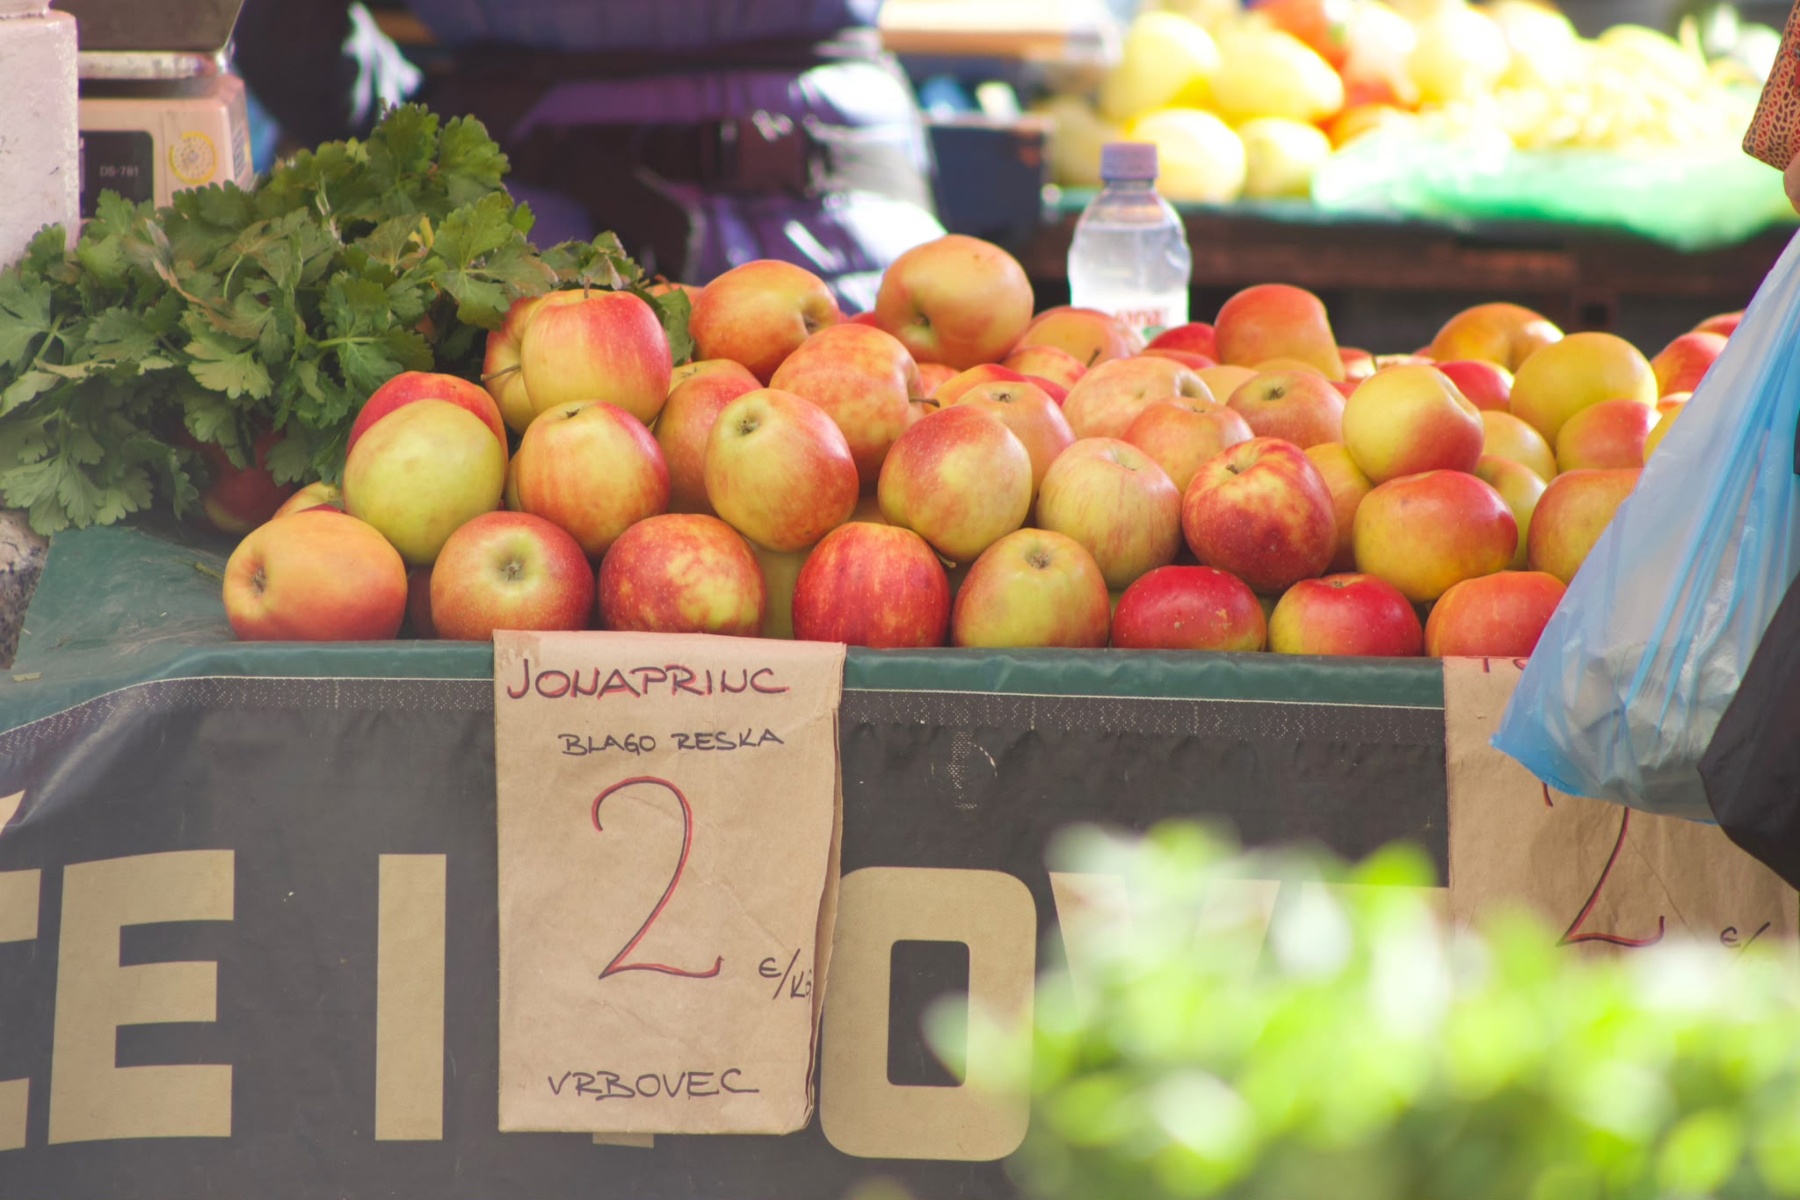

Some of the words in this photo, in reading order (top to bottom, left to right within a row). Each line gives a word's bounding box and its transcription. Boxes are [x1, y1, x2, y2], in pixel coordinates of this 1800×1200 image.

[507, 658, 790, 700] JONAPRINC
[557, 732, 656, 756] BLAGO
[670, 727, 785, 751] RESKA
[591, 775, 724, 979] 2
[547, 1068, 760, 1101] VRBOVEC
